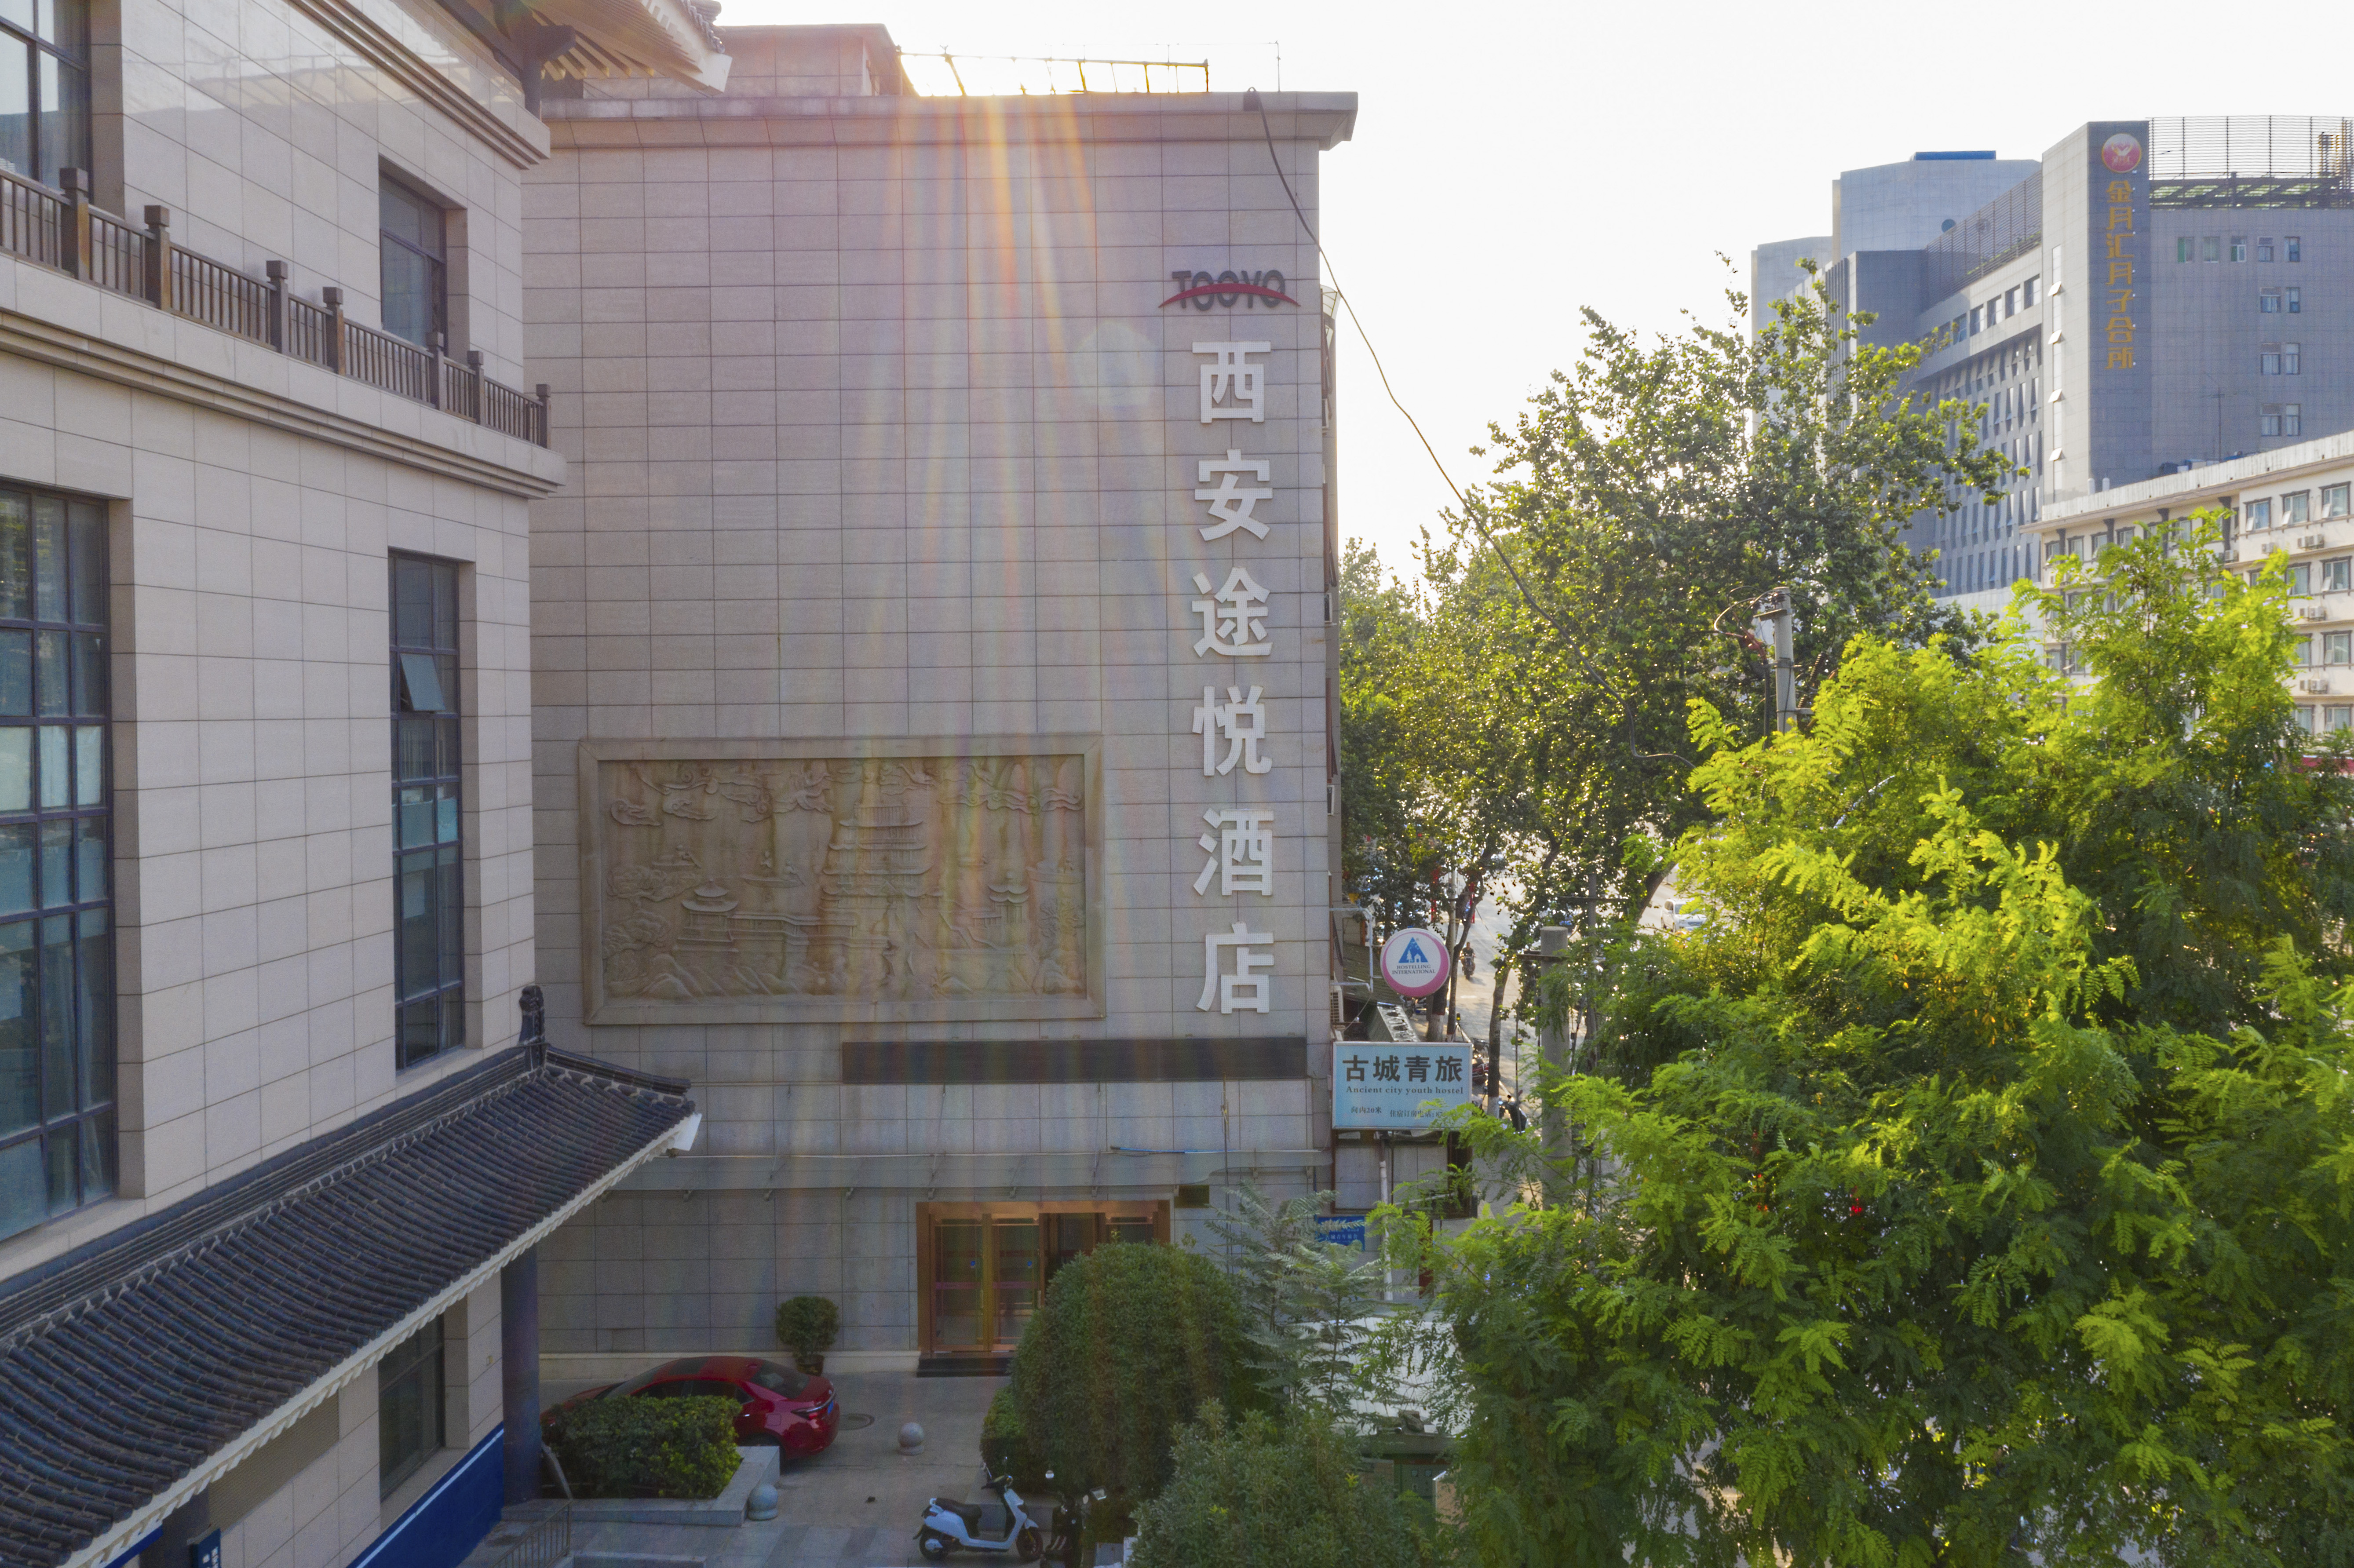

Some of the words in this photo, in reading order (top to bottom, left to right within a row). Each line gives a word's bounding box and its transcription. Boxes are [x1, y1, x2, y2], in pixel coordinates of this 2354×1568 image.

[1192, 340, 1274, 1014] 西安途悦酒店
[1342, 1054, 1463, 1083] 古城青旅
[1385, 1086, 1402, 1095] city
[1405, 1086, 1432, 1095] youth
